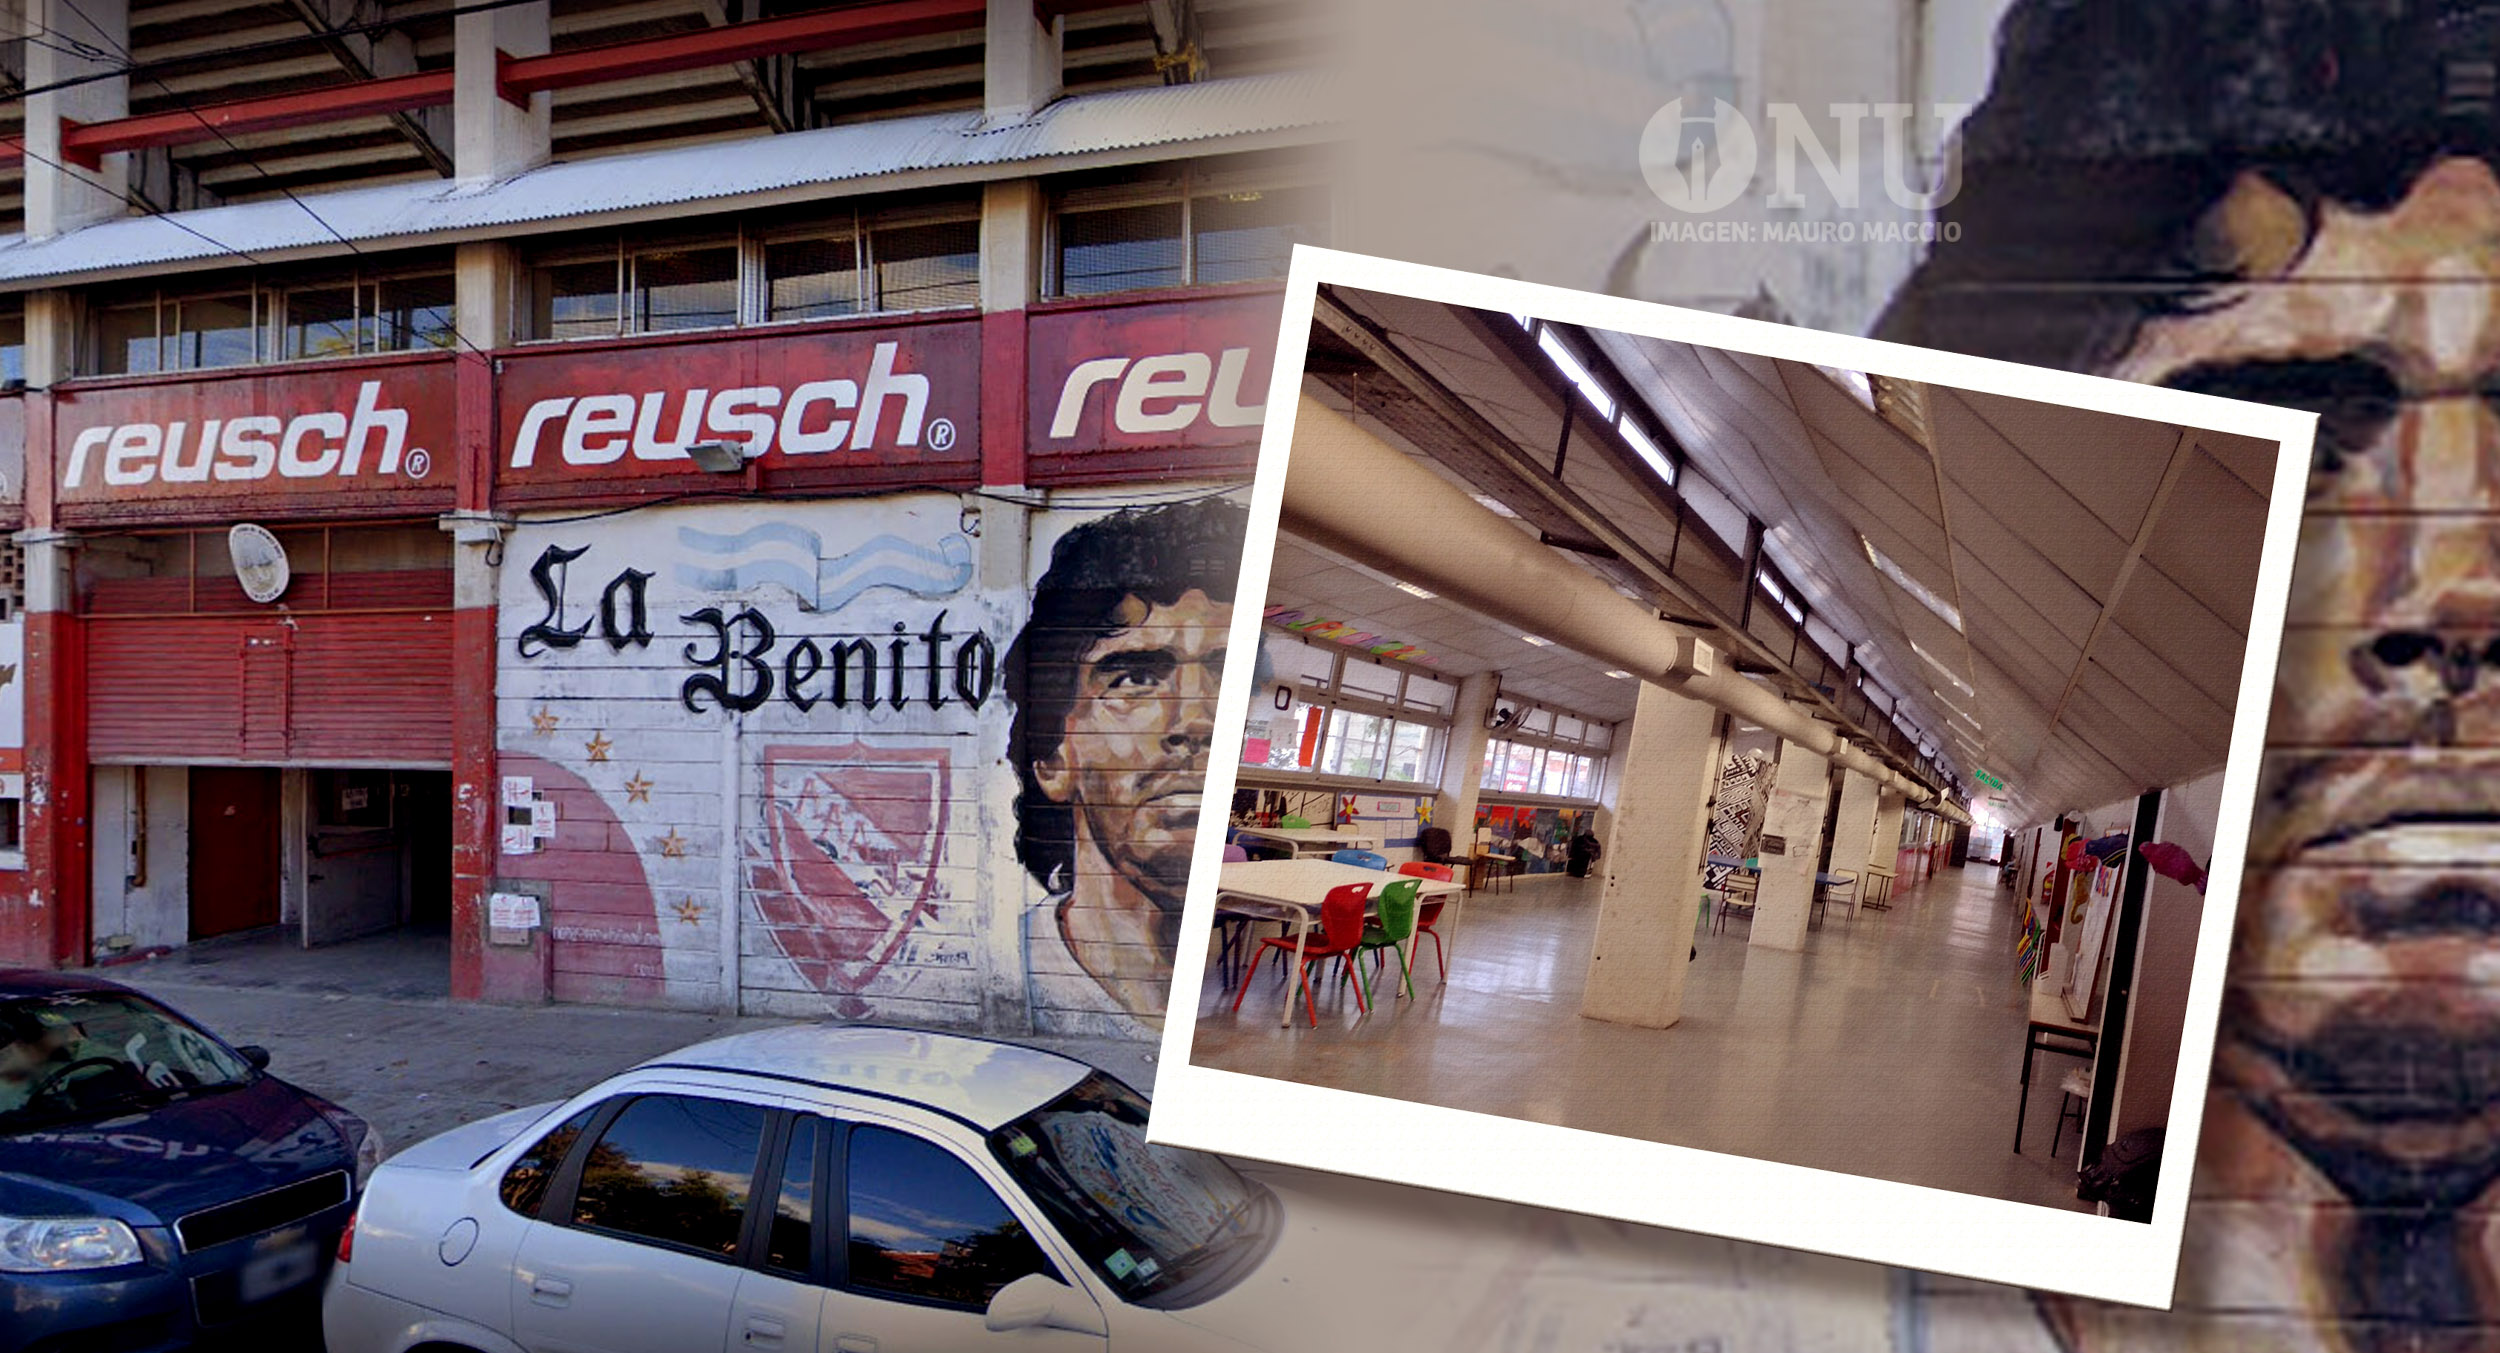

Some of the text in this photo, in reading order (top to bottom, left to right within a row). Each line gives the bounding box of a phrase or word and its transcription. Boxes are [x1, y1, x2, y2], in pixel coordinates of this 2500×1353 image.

[64, 381, 409, 488] reusch
[510, 341, 930, 469] reusch
[518, 543, 656, 659] La
[680, 606, 995, 714] Benito
[1975, 769, 2005, 791] SALIDA
